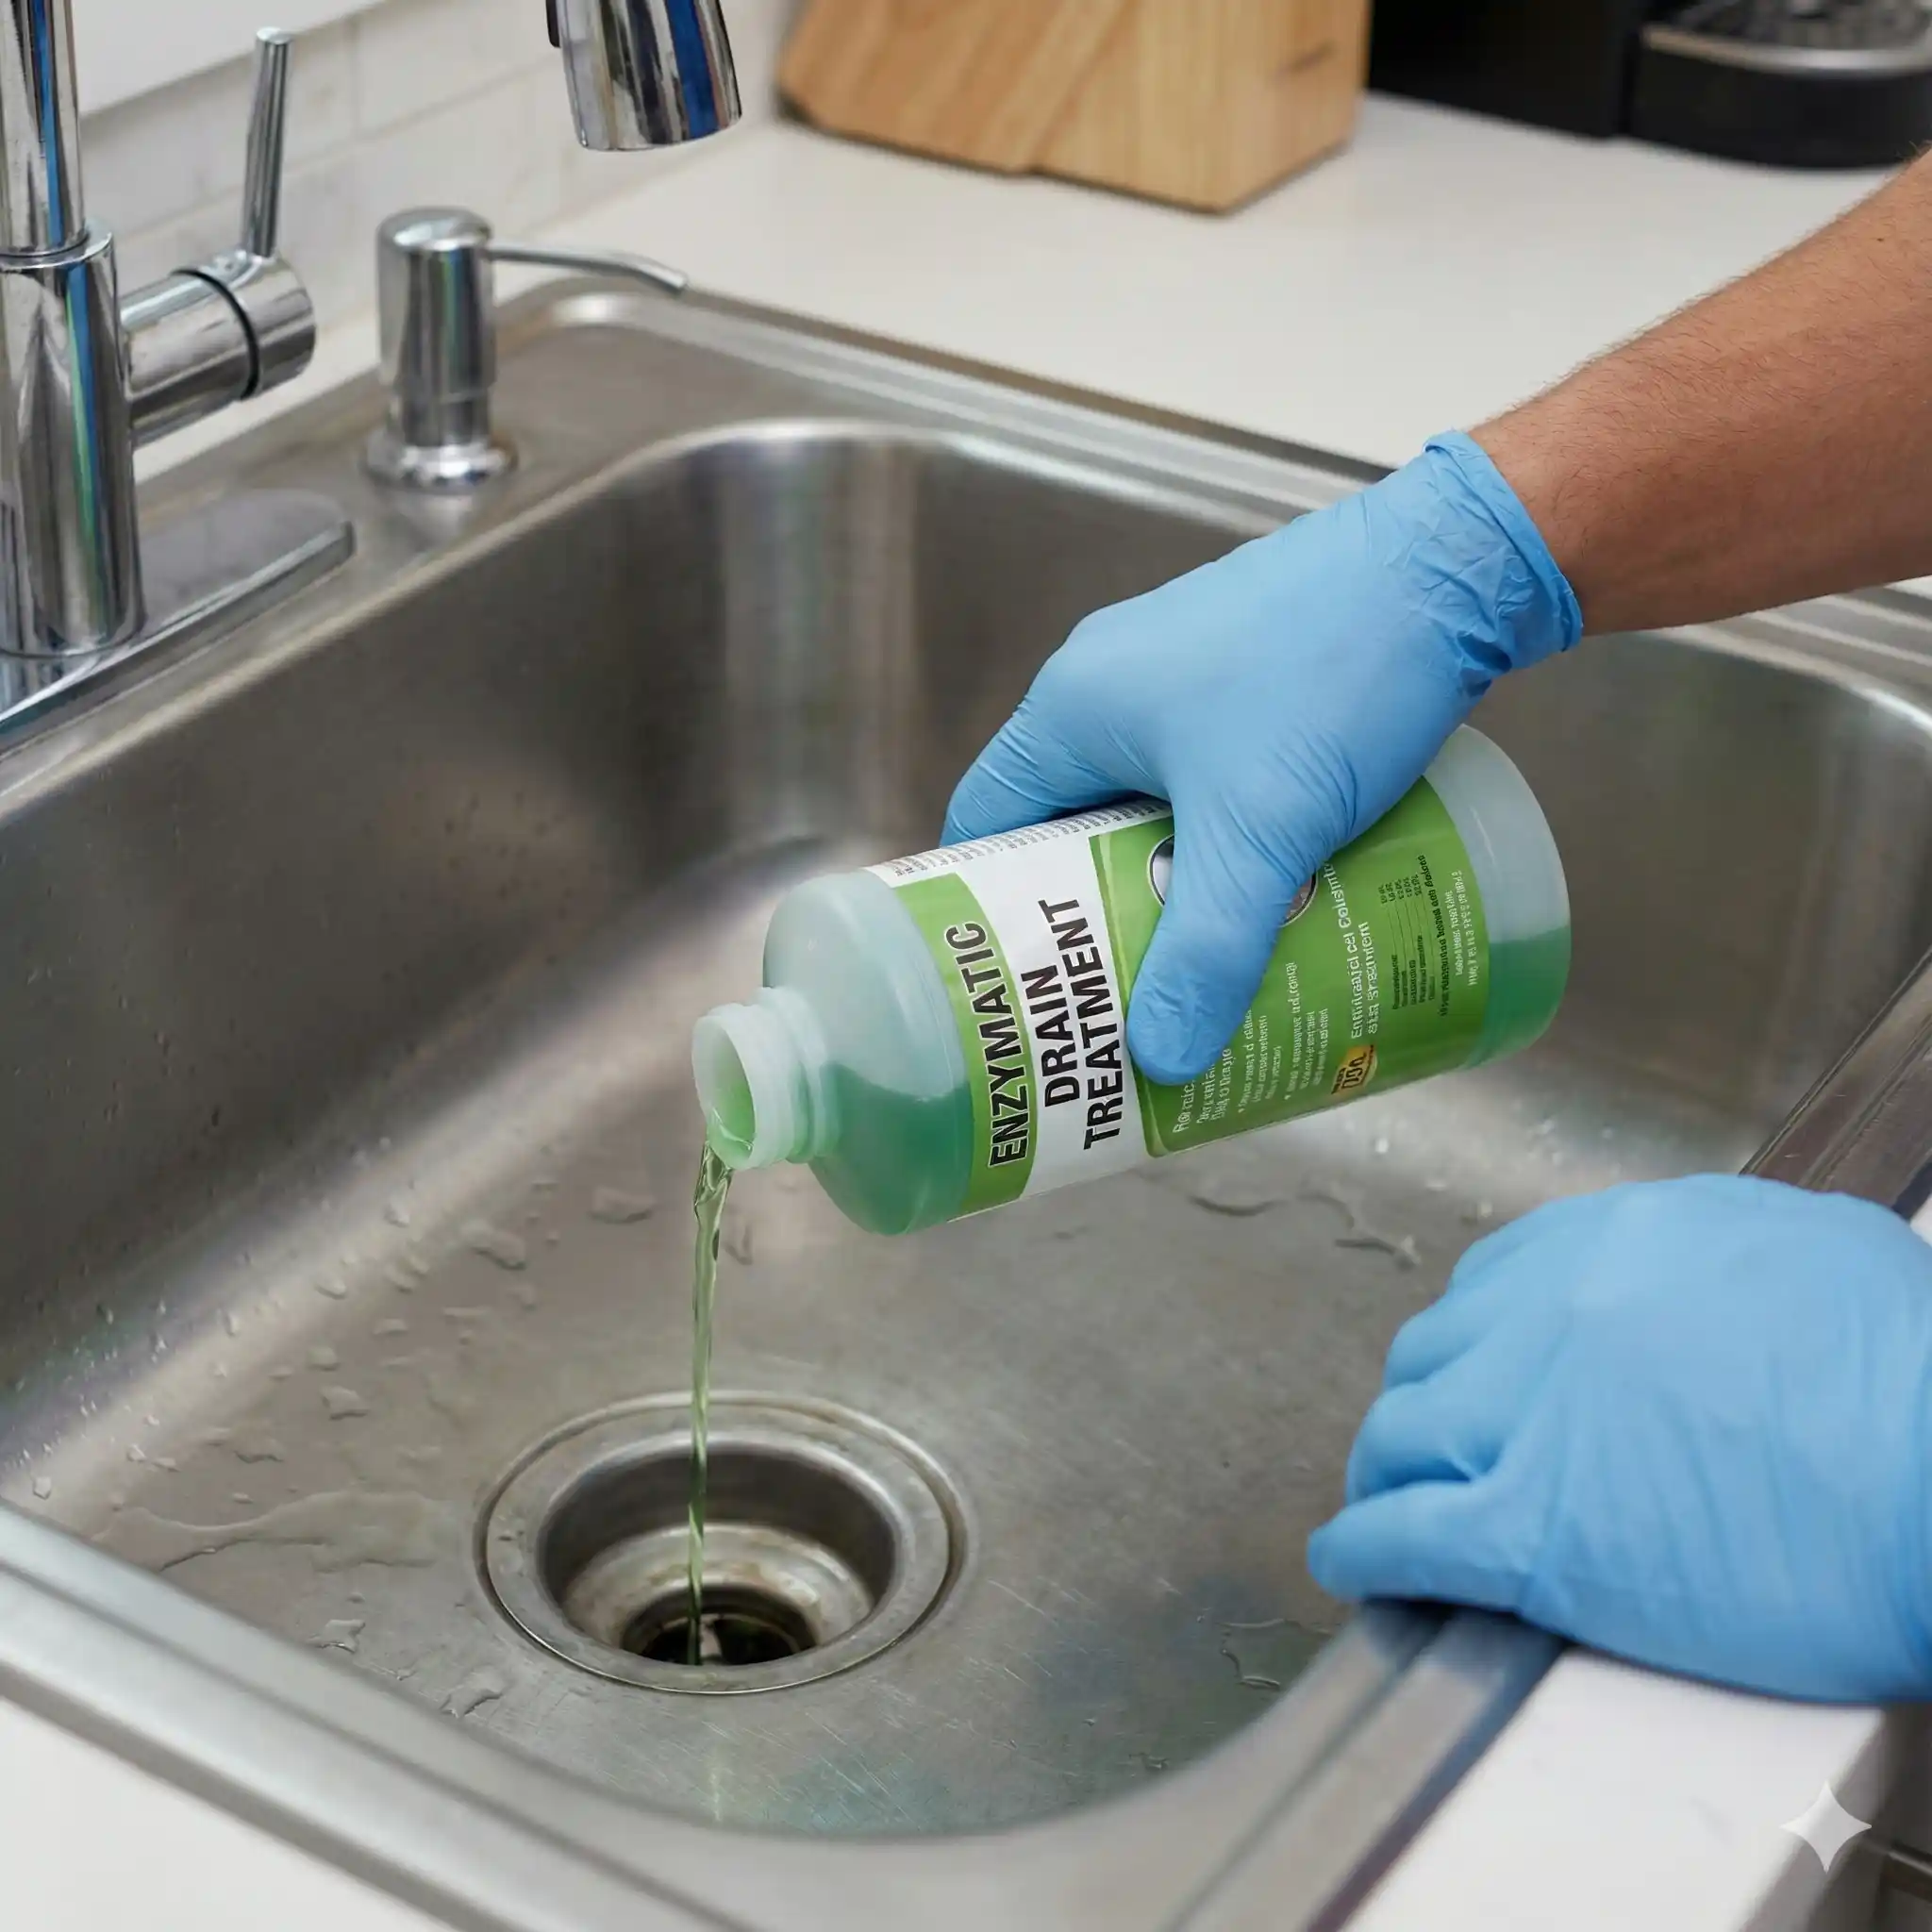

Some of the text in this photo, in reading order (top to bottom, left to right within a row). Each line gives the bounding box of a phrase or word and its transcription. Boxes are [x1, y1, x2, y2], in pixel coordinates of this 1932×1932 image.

[945, 920, 1030, 1167] ENZYMATIC
[1021, 964, 1081, 1108] DRAIN
[1038, 898, 1124, 1150] TREATMENT
